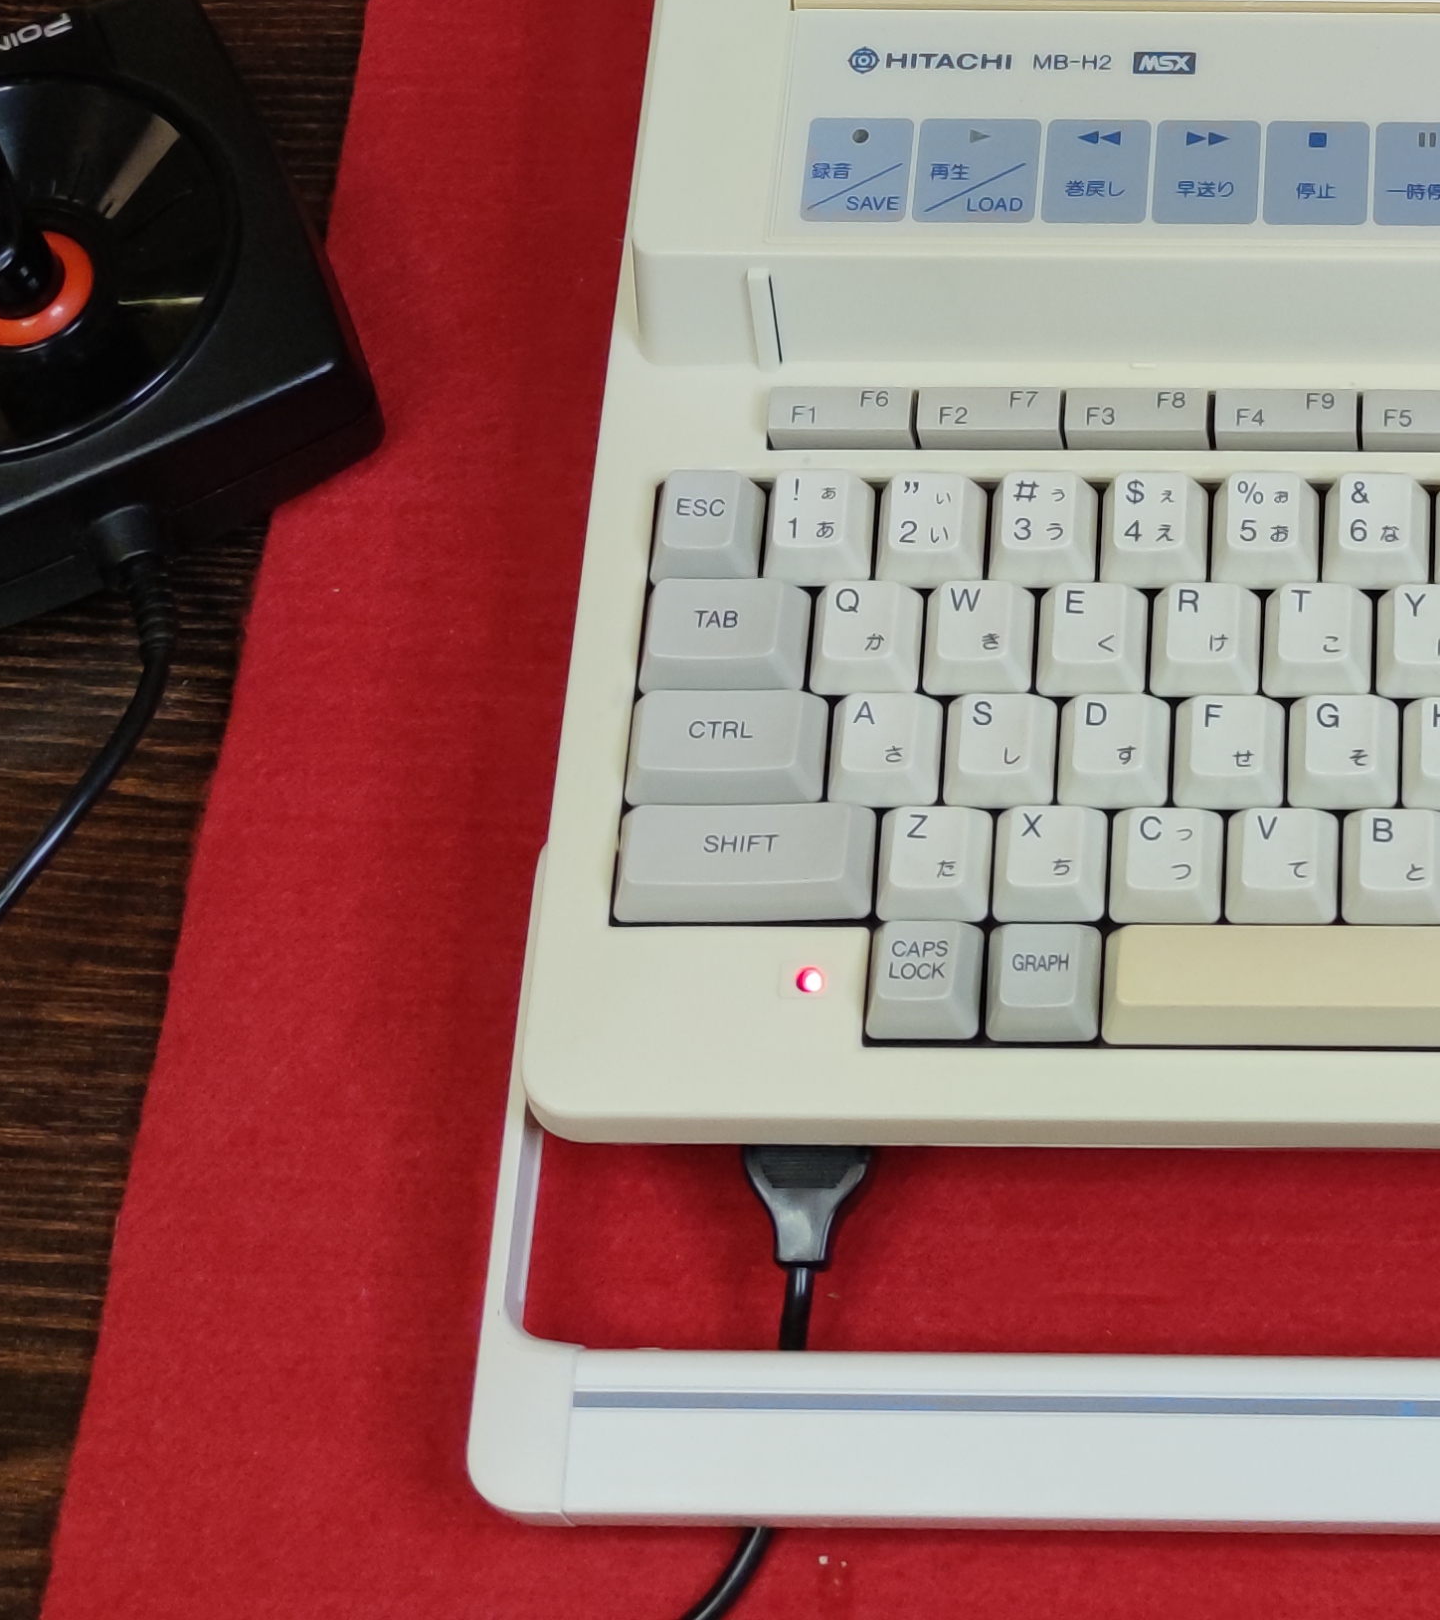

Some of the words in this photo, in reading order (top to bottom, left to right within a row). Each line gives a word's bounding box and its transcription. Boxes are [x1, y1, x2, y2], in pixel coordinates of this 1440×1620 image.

[885, 53, 1013, 71] HITACHI
[1033, 54, 1113, 71] MB-H2
[1136, 53, 1194, 73] MSX
[811, 162, 852, 180] 録音
[930, 163, 970, 181] 再生
[1065, 180, 1126, 198] 巻戻し
[1175, 180, 1235, 198] 早送り
[1296, 182, 1337, 200] 停止
[846, 196, 900, 212] SAVE
[966, 196, 1024, 213] LOAD
[860, 387, 888, 407] F6
[1009, 390, 1039, 409] F7
[1157, 392, 1185, 408] F8
[1306, 391, 1335, 410] F9
[792, 406, 815, 424] F1
[939, 407, 967, 425] F2
[1087, 407, 1115, 426] F3
[1236, 408, 1265, 426] F4
[1384, 409, 1412, 427] F5
[676, 498, 725, 517] ESC
[788, 517, 797, 538] 1
[816, 521, 834, 538] あ
[899, 521, 917, 543] 2
[931, 527, 948, 543] い
[1014, 518, 1031, 540] 3
[1046, 523, 1063, 540] う
[1124, 520, 1142, 542] 4
[1156, 524, 1174, 542] え
[1240, 520, 1257, 542] 5
[1270, 525, 1289, 542] お
[1350, 519, 1367, 542] 6
[1380, 525, 1399, 542] な
[836, 588, 859, 613] Q
[950, 588, 981, 612] W
[1066, 590, 1085, 614] E
[1178, 589, 1199, 613] R
[1291, 590, 1312, 613] T
[1404, 593, 1426, 617] Y
[694, 610, 738, 628] TAB
[853, 701, 875, 725] A
[973, 701, 992, 725] S
[1086, 702, 1107, 726] D
[1205, 704, 1223, 727] F
[1317, 703, 1339, 728] G
[689, 721, 753, 739] CTRL
[907, 814, 928, 839] Z
[1021, 813, 1043, 838] X
[1140, 816, 1162, 841] C
[1257, 815, 1278, 840] V
[1373, 817, 1393, 843] B
[703, 834, 779, 853] SHIFT
[892, 940, 948, 958] CAPS
[889, 962, 945, 980] LOCK
[1012, 953, 1069, 972] GRAPH
